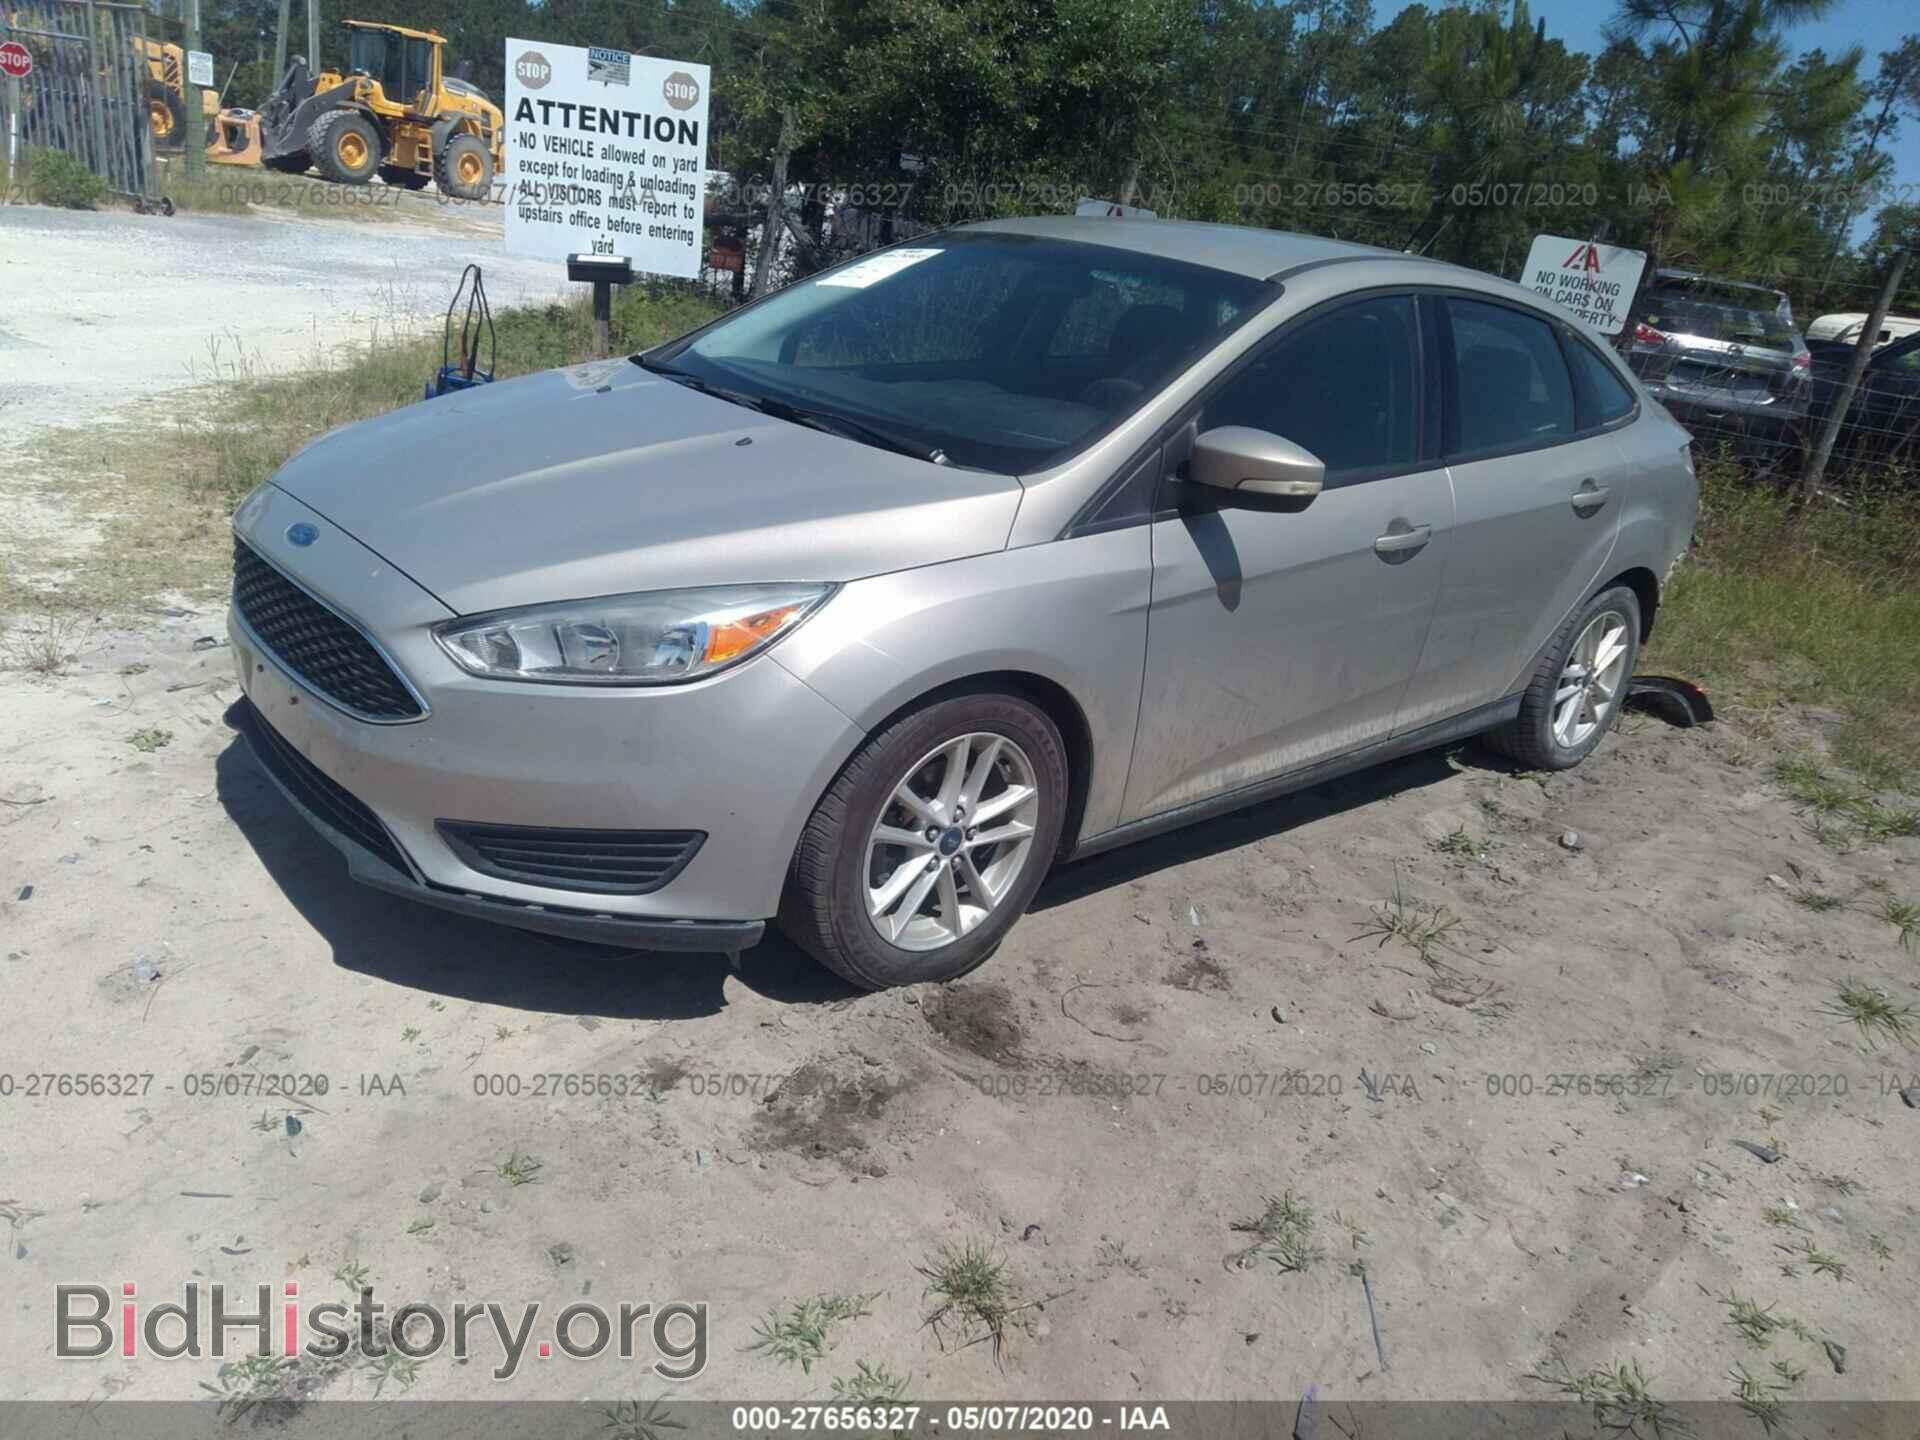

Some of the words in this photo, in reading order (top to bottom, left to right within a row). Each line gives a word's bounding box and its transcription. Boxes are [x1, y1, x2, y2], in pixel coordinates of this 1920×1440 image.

[0, 51, 30, 67] STOP
[591, 50, 629, 64] NOTICE
[518, 62, 549, 79] STOP
[665, 82, 697, 100] STOP
[514, 97, 699, 146] ATTENTION
[519, 131, 537, 149] NO
[543, 135, 594, 158] VEHICLE
[601, 144, 645, 165] allowed
[652, 155, 666, 168] on
[672, 156, 698, 174] yard
[519, 160, 559, 178] except
[562, 163, 578, 179] for
[581, 164, 624, 189] loading
[628, 171, 636, 188] &
[640, 176, 696, 200] unloading
[519, 179, 541, 197] ALL
[548, 182, 602, 206] VISITORS
[608, 194, 636, 212] must
[643, 199, 677, 218] report
[683, 204, 695, 219] to
[518, 205, 563, 225] upstairs
[569, 209, 601, 229] office
[607, 215, 642, 235] before
[648, 223, 694, 246] entering
[591, 238, 614, 255] yard
[1536, 270, 1556, 285] NO
[1559, 274, 1621, 297] WORKING
[1555, 289, 1591, 308] CARS
[1594, 296, 1615, 313] ON
